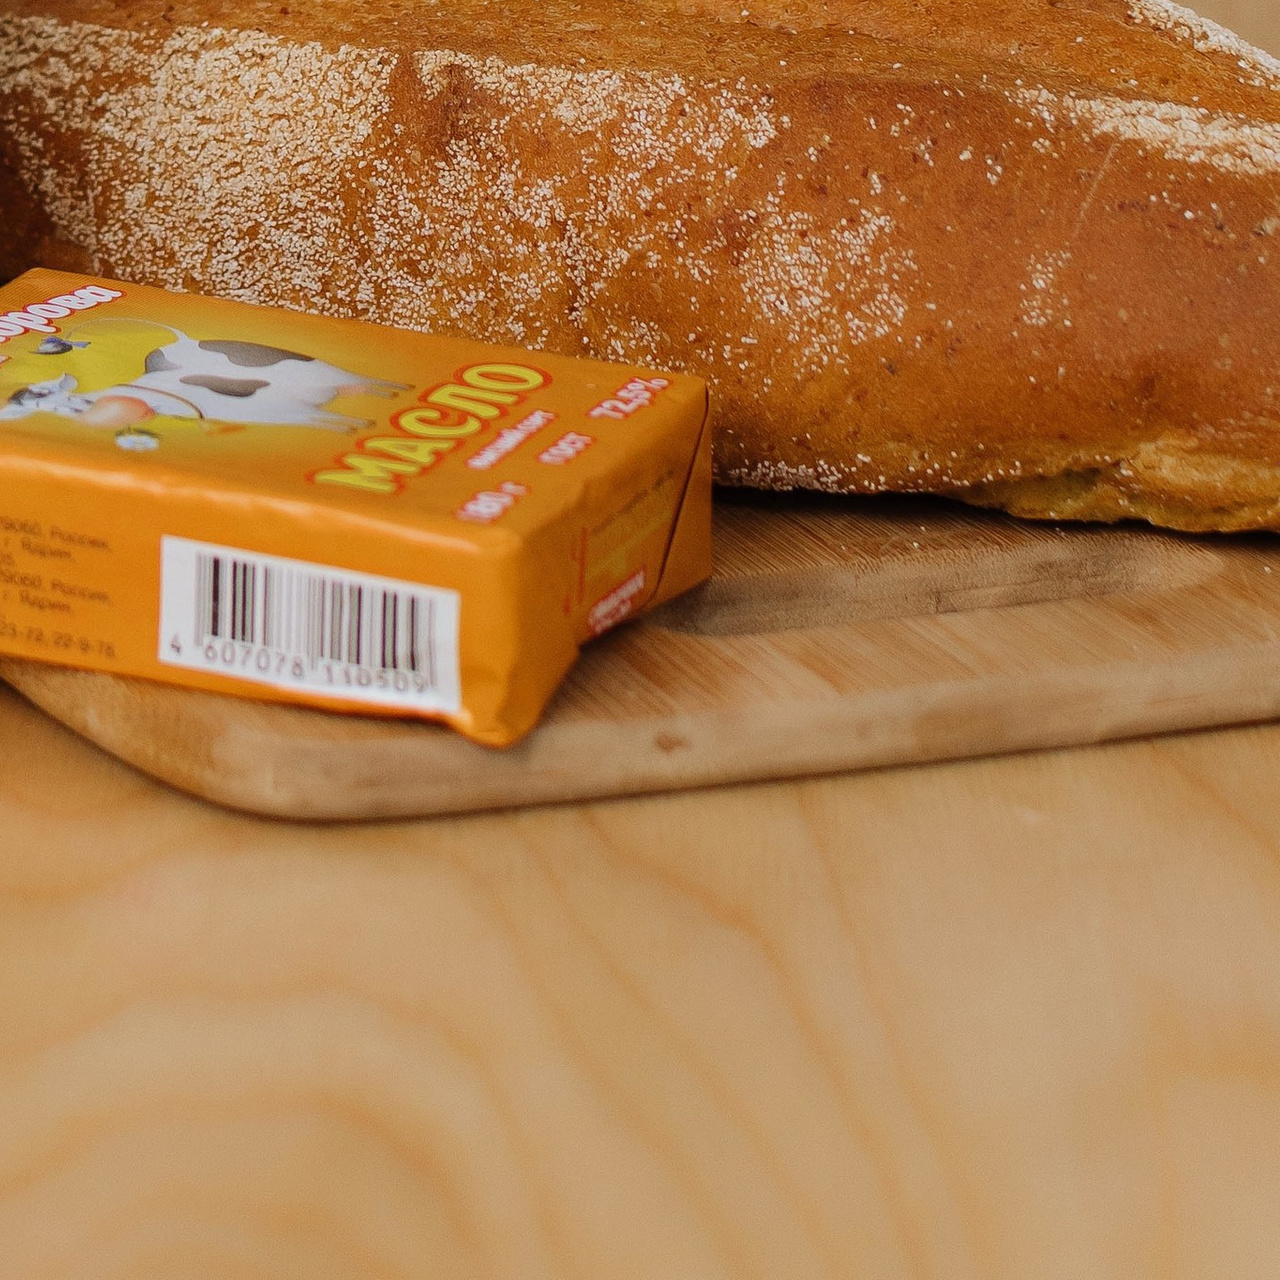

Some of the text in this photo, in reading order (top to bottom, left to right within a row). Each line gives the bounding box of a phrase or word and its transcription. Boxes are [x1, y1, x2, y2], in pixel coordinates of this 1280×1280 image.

[314, 362, 548, 493] МАСЛО
[168, 632, 429, 694] 4 607078 110509
